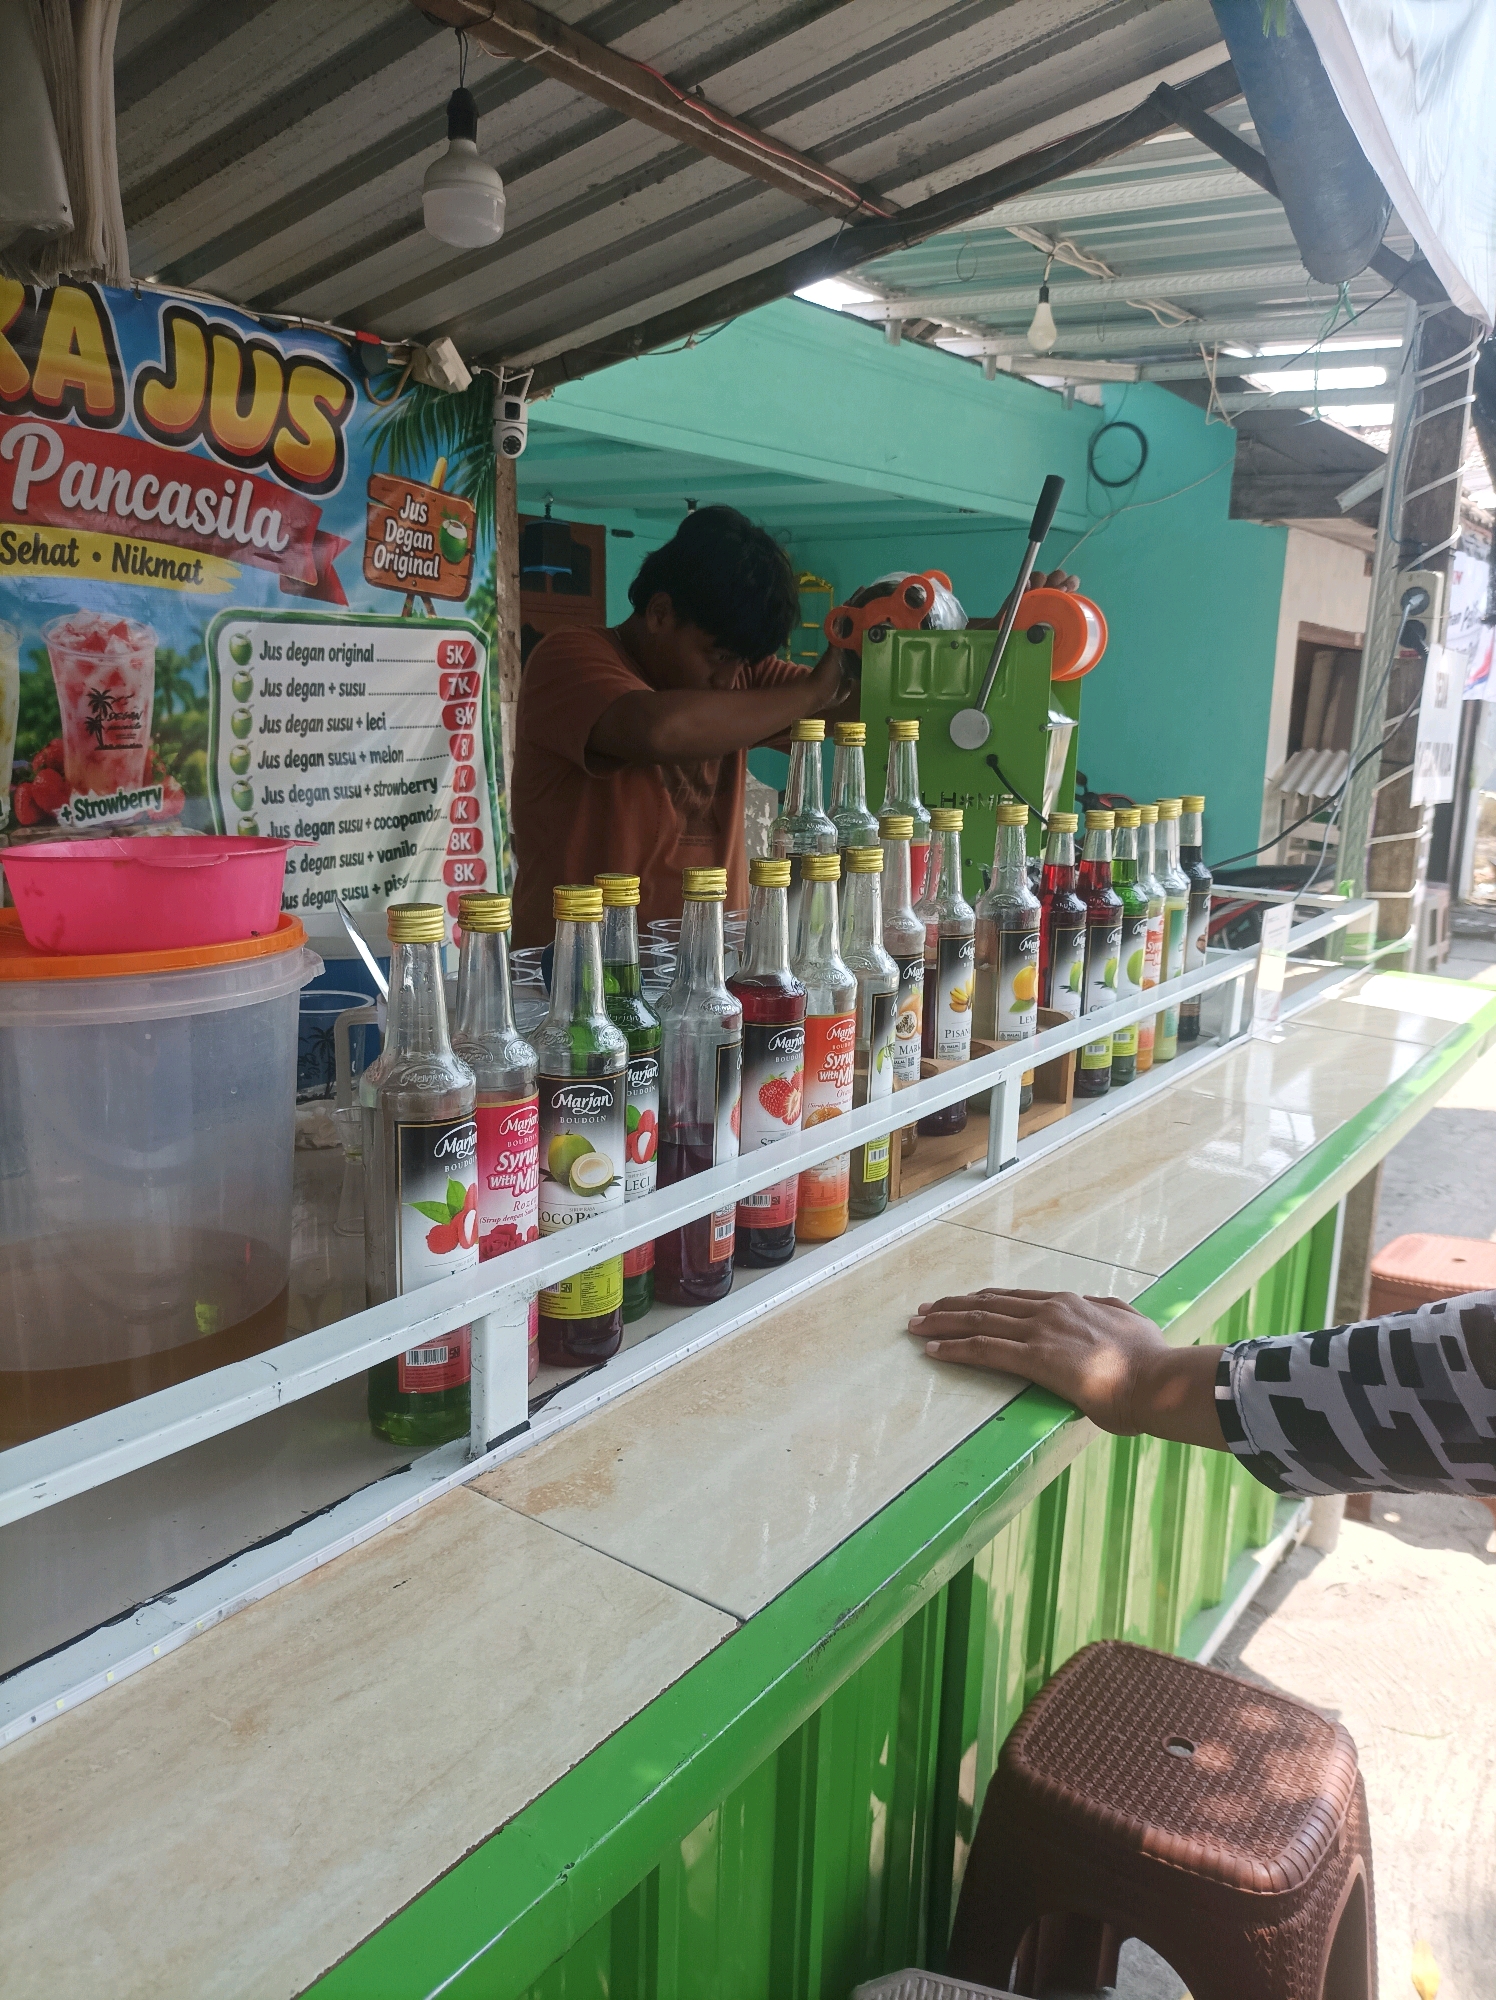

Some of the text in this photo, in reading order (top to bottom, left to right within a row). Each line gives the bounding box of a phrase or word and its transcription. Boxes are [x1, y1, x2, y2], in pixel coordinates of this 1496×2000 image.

[141, 315, 349, 484] JUS
[1, 422, 289, 552] Pancasila
[400, 494, 428, 523] Jus
[385, 518, 433, 552] Degan
[0, 531, 205, 585] Sehat Nikmat
[374, 544, 440, 579] Original
[259, 640, 465, 667] Jus degan original 5K
[259, 677, 283, 697] Jus
[286, 677, 325, 702] degan
[339, 682, 366, 697] susu
[447, 677, 471, 695] 7K
[259, 714, 282, 734] Jus
[285, 714, 324, 738] degan
[326, 716, 354, 733] susu
[366, 711, 387, 731] leci
[455, 706, 475, 725] 8K
[258, 750, 281, 770] Jus
[284, 749, 325, 772] degan
[328, 751, 357, 767] susu
[370, 745, 404, 764] melon
[460, 738, 470, 757] 8
[261, 786, 285, 805] Jus
[288, 783, 331, 807] degan
[333, 785, 363, 800] susu
[267, 821, 291, 838] Jus
[294, 818, 335, 841] degan
[338, 816, 363, 833] susu
[285, 860, 297, 875] us
[300, 853, 336, 876] degan
[339, 851, 365, 868] susu
[450, 831, 472, 851] 8K
[302, 888, 339, 910] degan
[341, 885, 370, 902] susu
[453, 862, 476, 883] 8K
[944, 1027, 970, 1039] PISAN
[824, 1052, 854, 1070] Syru
[553, 1085, 613, 1115] Marjan
[627, 1085, 656, 1097] OUDOIN
[559, 1115, 607, 1124] BOUDOIN
[514, 1164, 539, 1197] Mil
[625, 1177, 650, 1192] LECI
